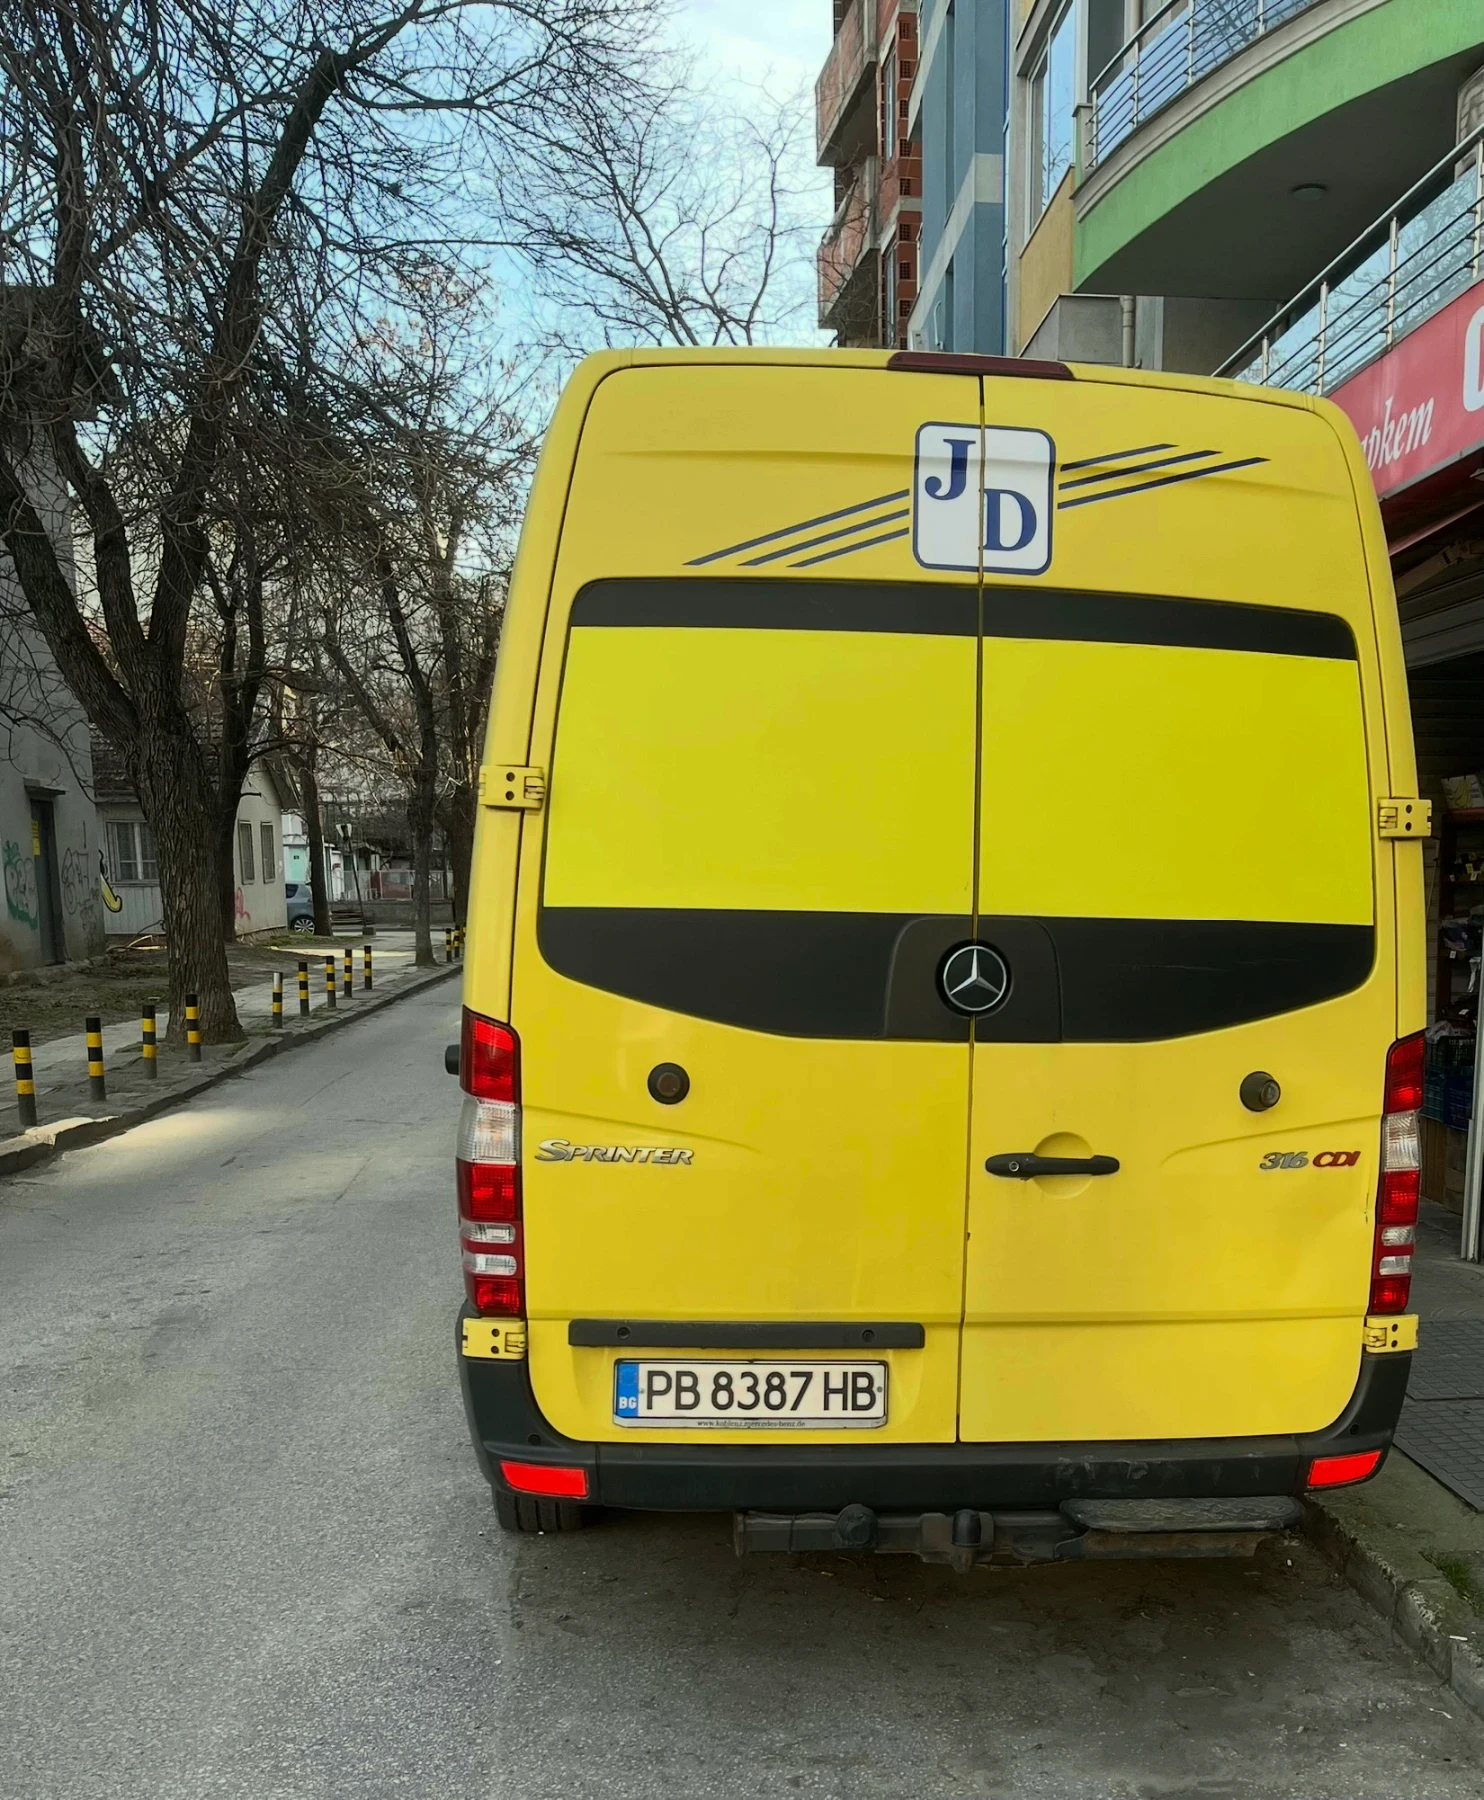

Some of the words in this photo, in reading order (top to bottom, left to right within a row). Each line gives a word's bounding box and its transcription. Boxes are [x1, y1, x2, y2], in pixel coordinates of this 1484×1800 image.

[534, 1139, 694, 1165] SPRINTER
[1259, 1151, 1309, 1169] 316
[1312, 1151, 1361, 1167] CDI
[646, 1370, 700, 1411] PB
[711, 1371, 813, 1411] 8387
[822, 1371, 876, 1411] HB
[618, 1396, 637, 1409] BG
